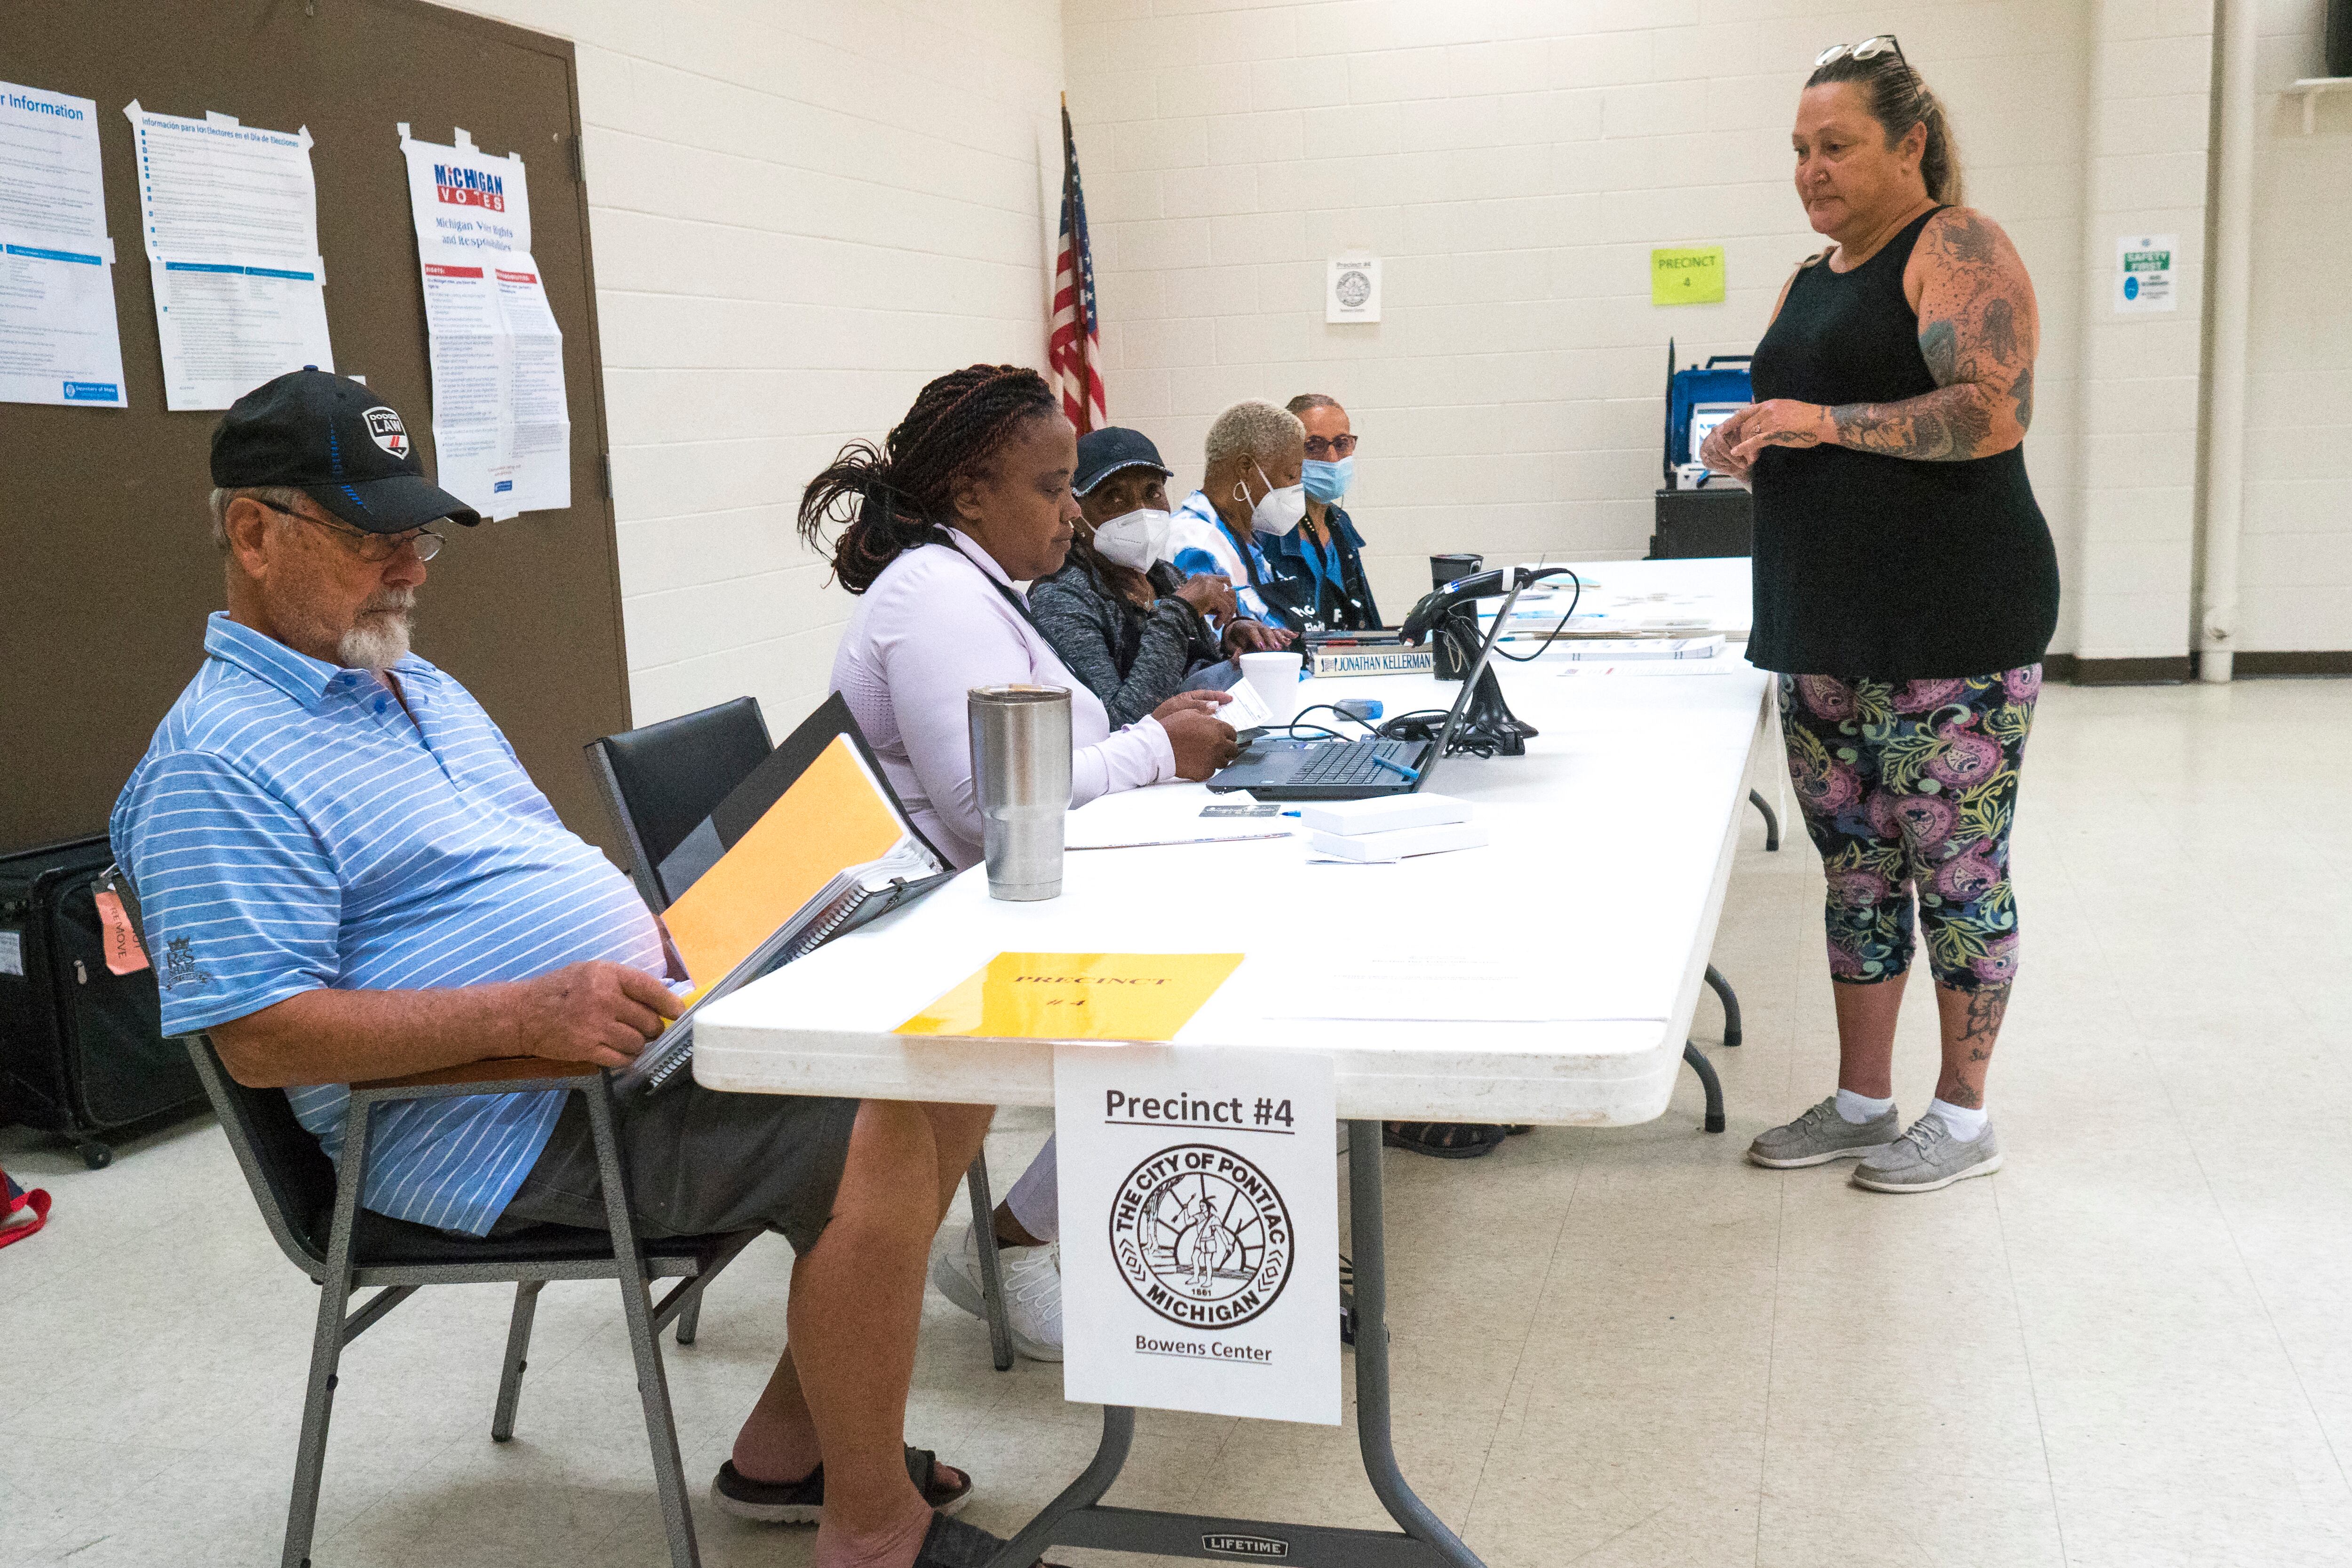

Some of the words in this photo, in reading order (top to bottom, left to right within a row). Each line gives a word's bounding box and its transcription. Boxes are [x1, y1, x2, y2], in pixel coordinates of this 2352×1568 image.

[9, 94, 83, 120] Information
[441, 188, 502, 211] VOTES
[436, 217, 473, 231] Michigan
[442, 234, 456, 245] and
[1658, 255, 1716, 270] PRECINCT
[1684, 277, 1691, 287] 4
[373, 420, 402, 433] LAW
[1338, 656, 1381, 671] JONATHAN
[1383, 653, 1430, 669] KELLERMAN
[110, 907, 127, 959] REMOVE
[1014, 976, 1172, 985] PRECINCT
[1106, 1090, 1243, 1123] Precinct
[1254, 1097, 1294, 1127] #4
[1116, 1189, 1143, 1232] THE
[1136, 1154, 1179, 1190] CITY
[1185, 1152, 1215, 1169] OF
[1217, 1157, 1286, 1244] PONTIAC
[1146, 1283, 1261, 1322] MICHIGAN
[1136, 1335, 1206, 1355] Bowens
[1212, 1342, 1272, 1361] Center
[1211, 1537, 1281, 1553] LIFETIME
